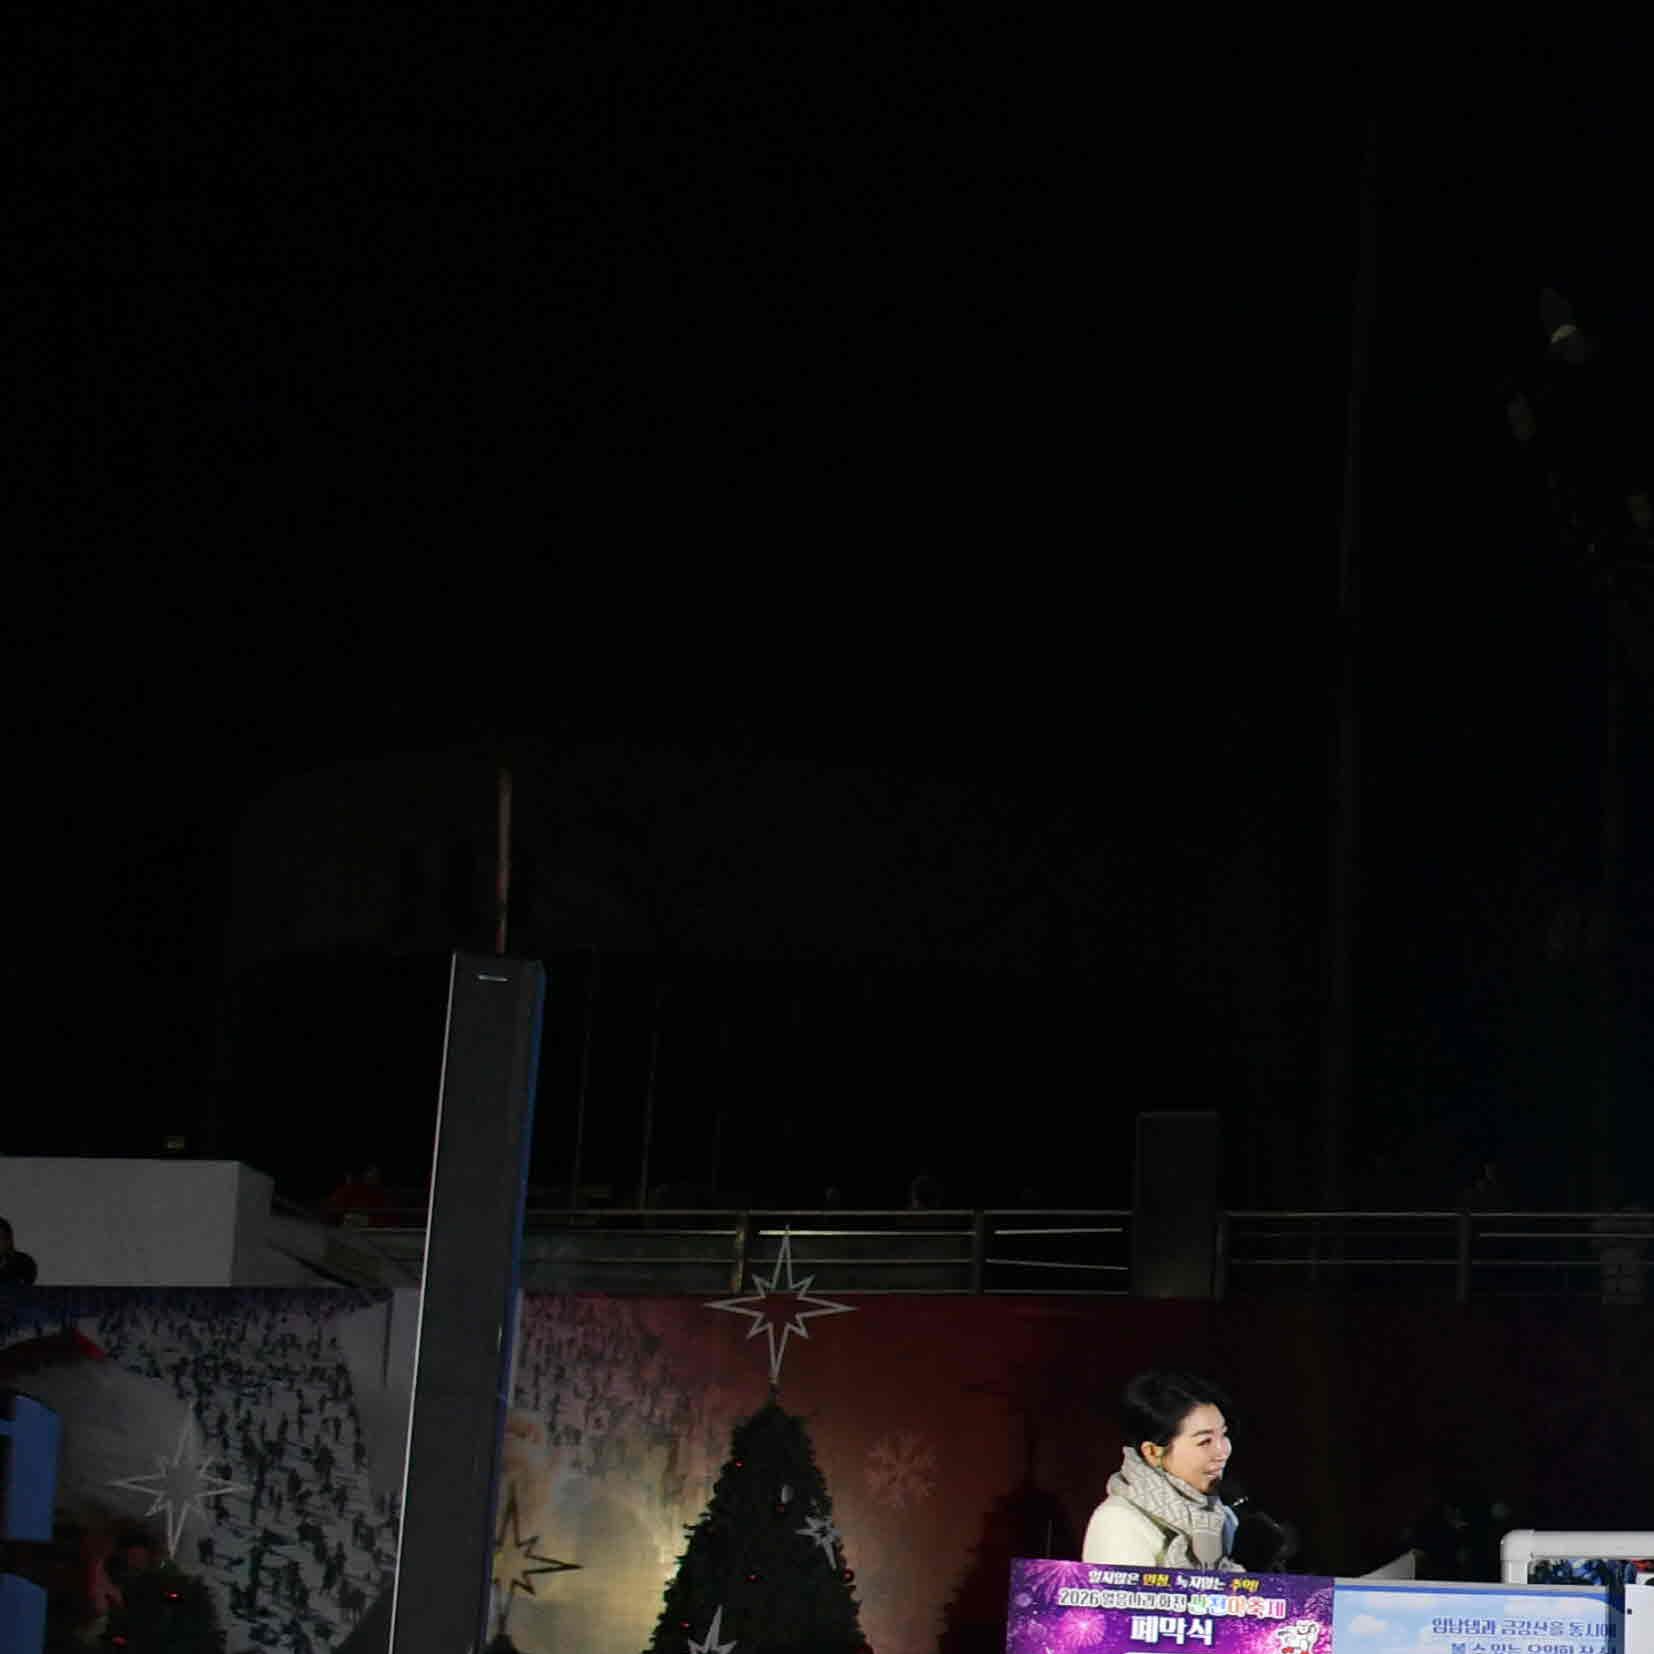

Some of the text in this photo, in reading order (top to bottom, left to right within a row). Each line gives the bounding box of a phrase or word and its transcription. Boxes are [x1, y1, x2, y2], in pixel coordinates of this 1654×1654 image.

[1059, 1588, 1099, 1607] 2026
[1131, 1616, 1213, 1645] 폐막식
[1501, 1619, 1565, 1637] 금강산을
